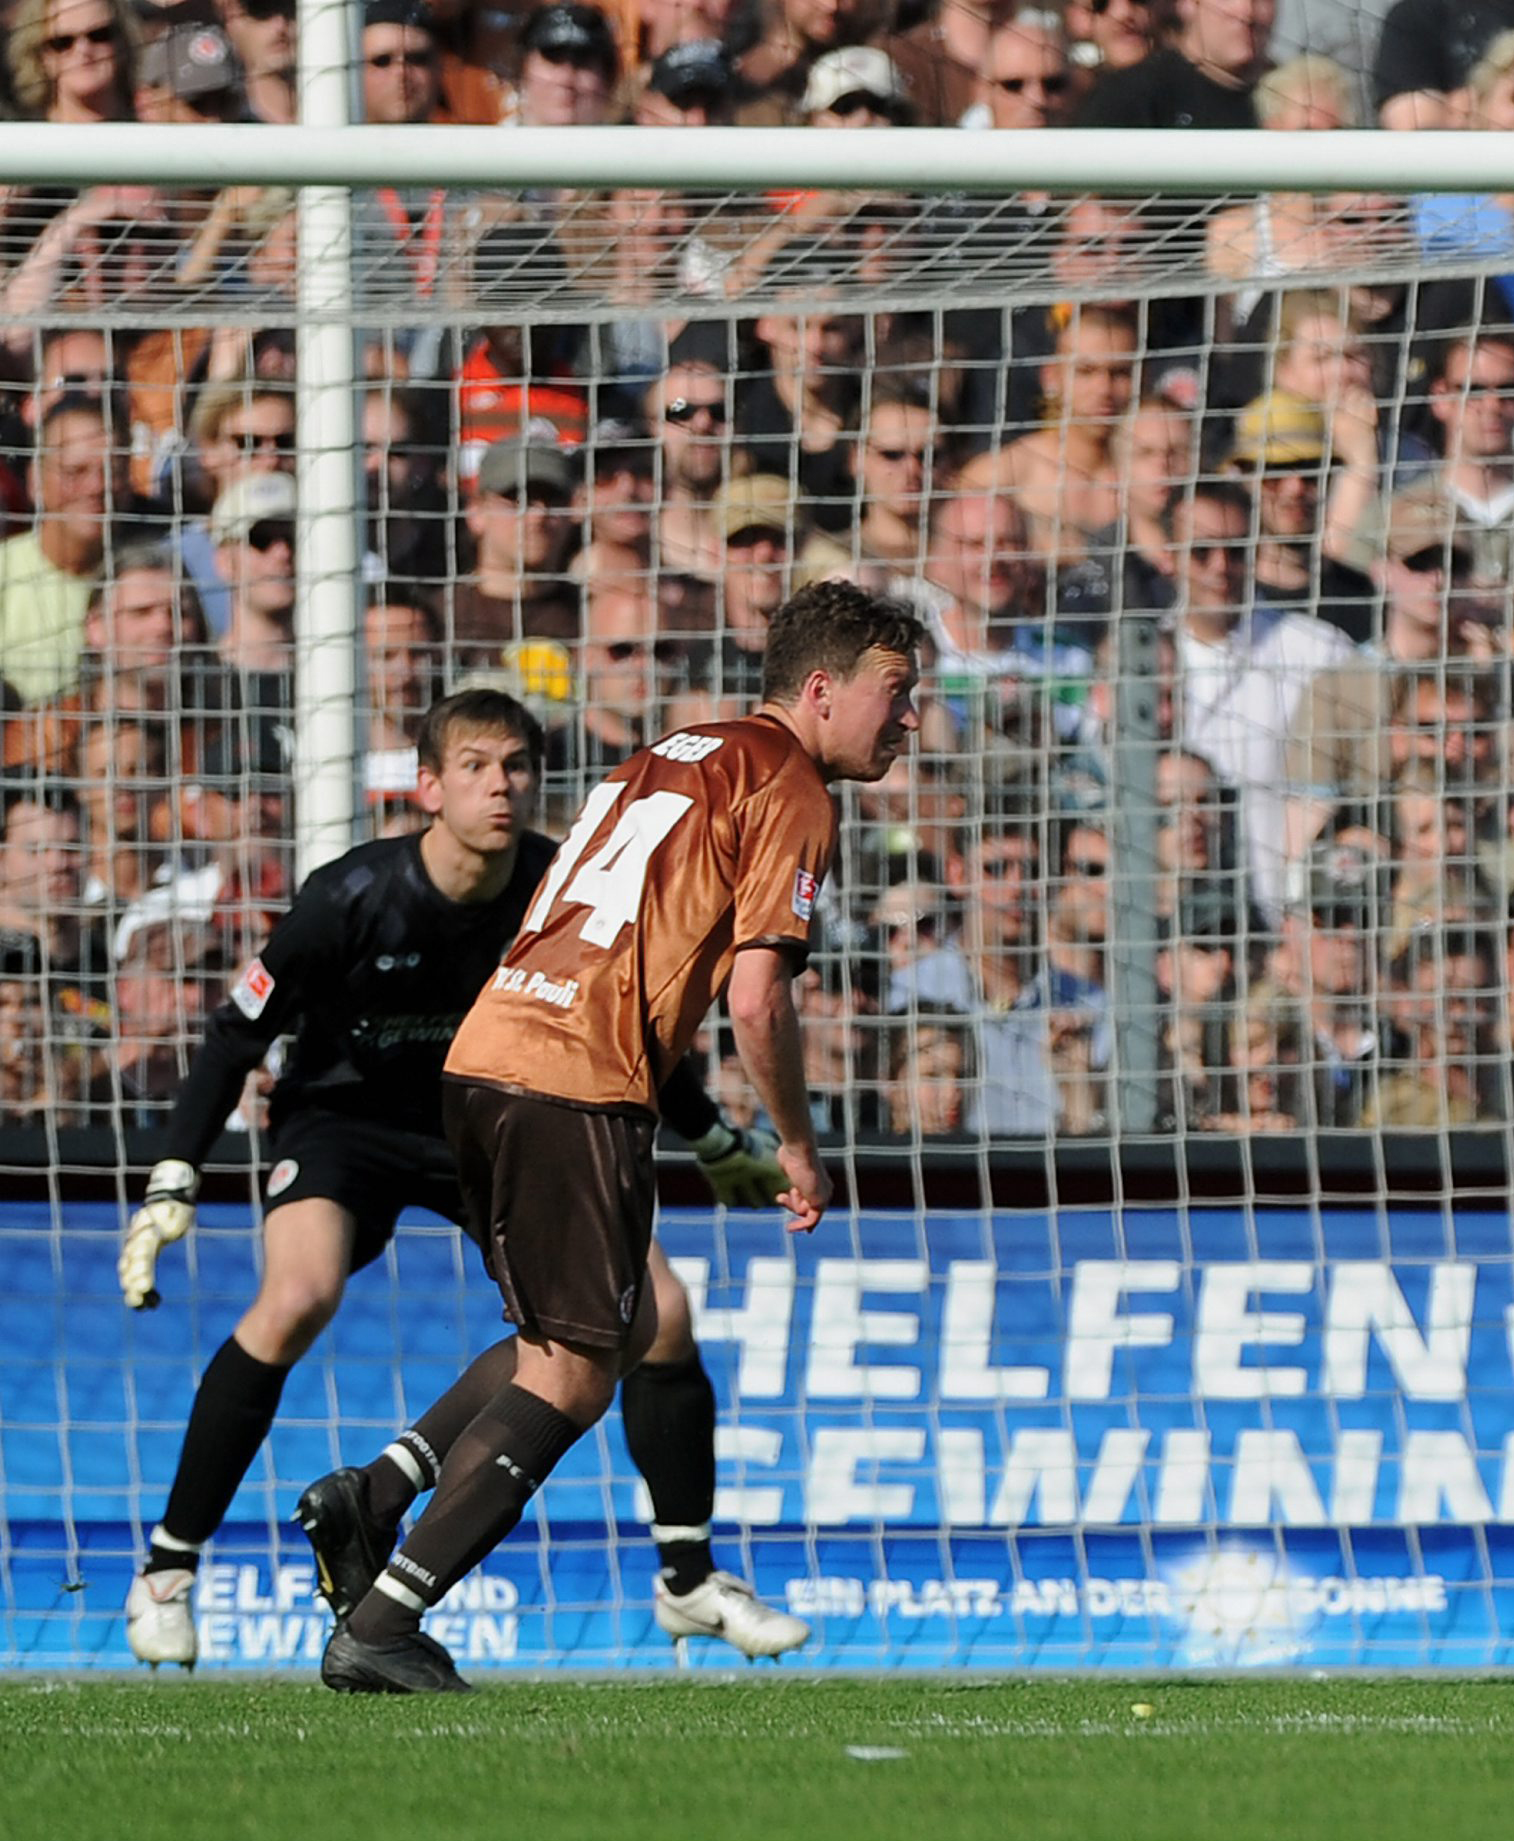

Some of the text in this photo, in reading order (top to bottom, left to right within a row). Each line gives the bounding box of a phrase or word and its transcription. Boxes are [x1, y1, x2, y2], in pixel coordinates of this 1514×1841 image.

[525, 780, 696, 950] 14
[524, 971, 580, 1009] Pauli
[668, 1256, 1477, 1400] HELFEN
[393, 1553, 437, 1588] OTBALL
[424, 1575, 519, 1611] ND
[871, 1579, 1002, 1616] PLATZ
[1011, 1578, 1080, 1615] AN
[1085, 1578, 1172, 1616] DER
[197, 1612, 519, 1662] EWIEN
